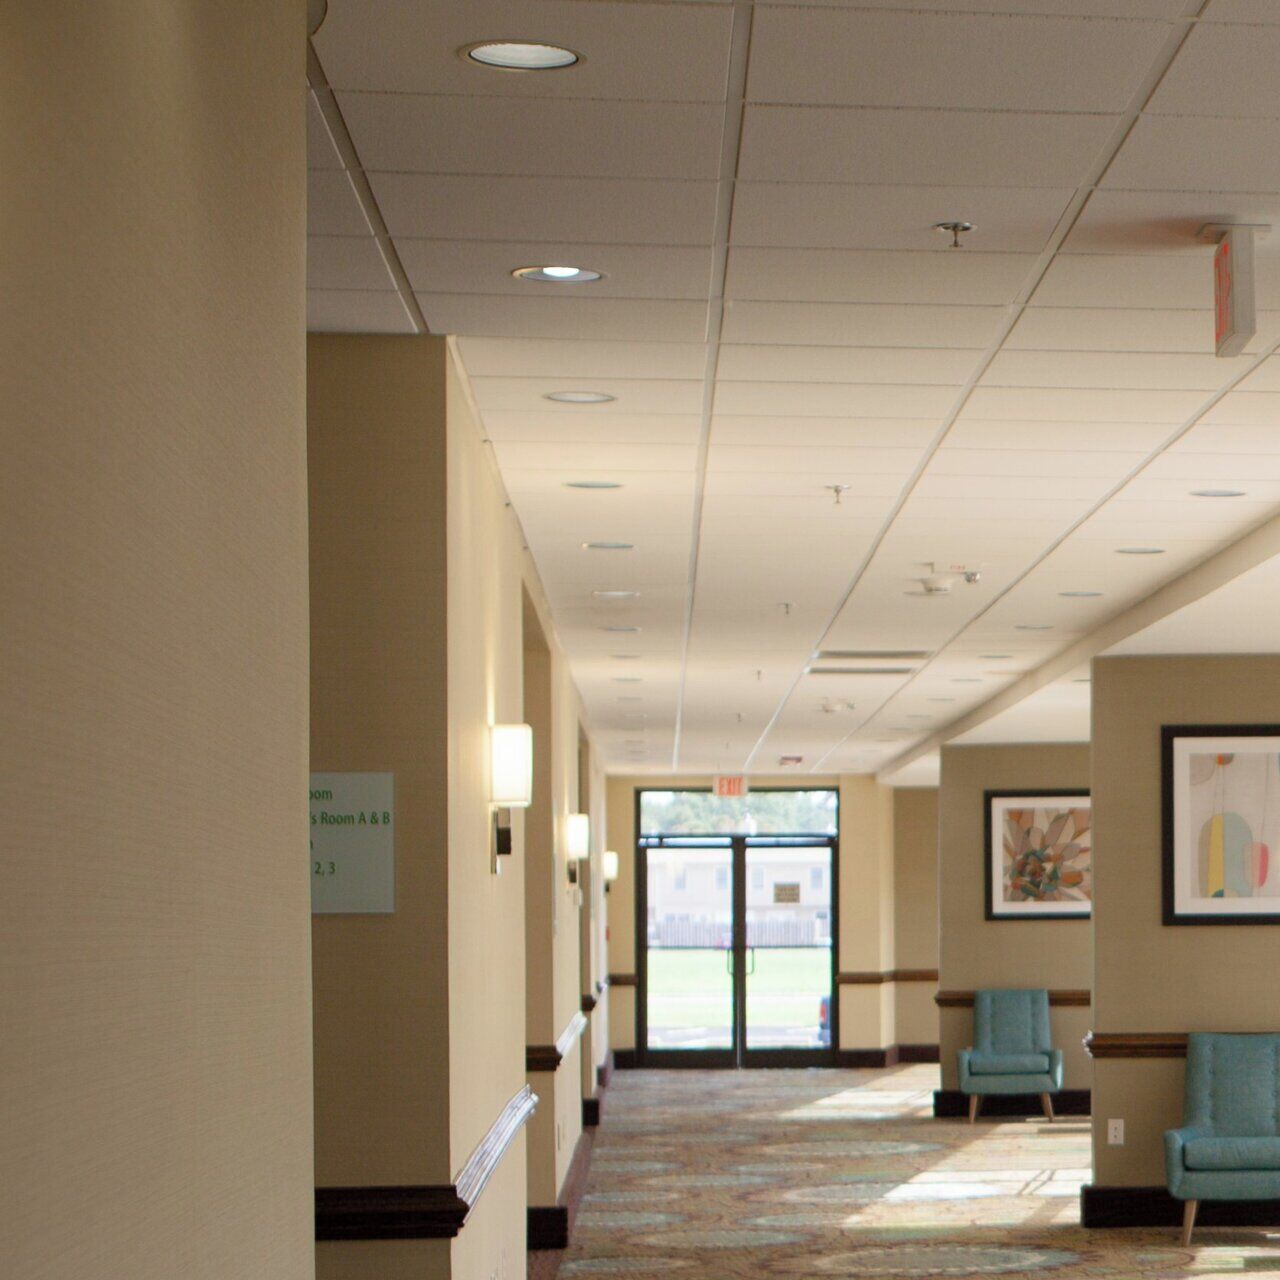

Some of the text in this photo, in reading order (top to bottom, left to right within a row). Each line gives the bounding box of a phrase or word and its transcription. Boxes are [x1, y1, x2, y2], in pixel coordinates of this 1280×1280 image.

[718, 776, 744, 795] EXIT
[320, 811, 355, 825] Room
[358, 812, 367, 825] A
[370, 812, 379, 825] &
[383, 812, 391, 825] B
[328, 862, 336, 874] 3
